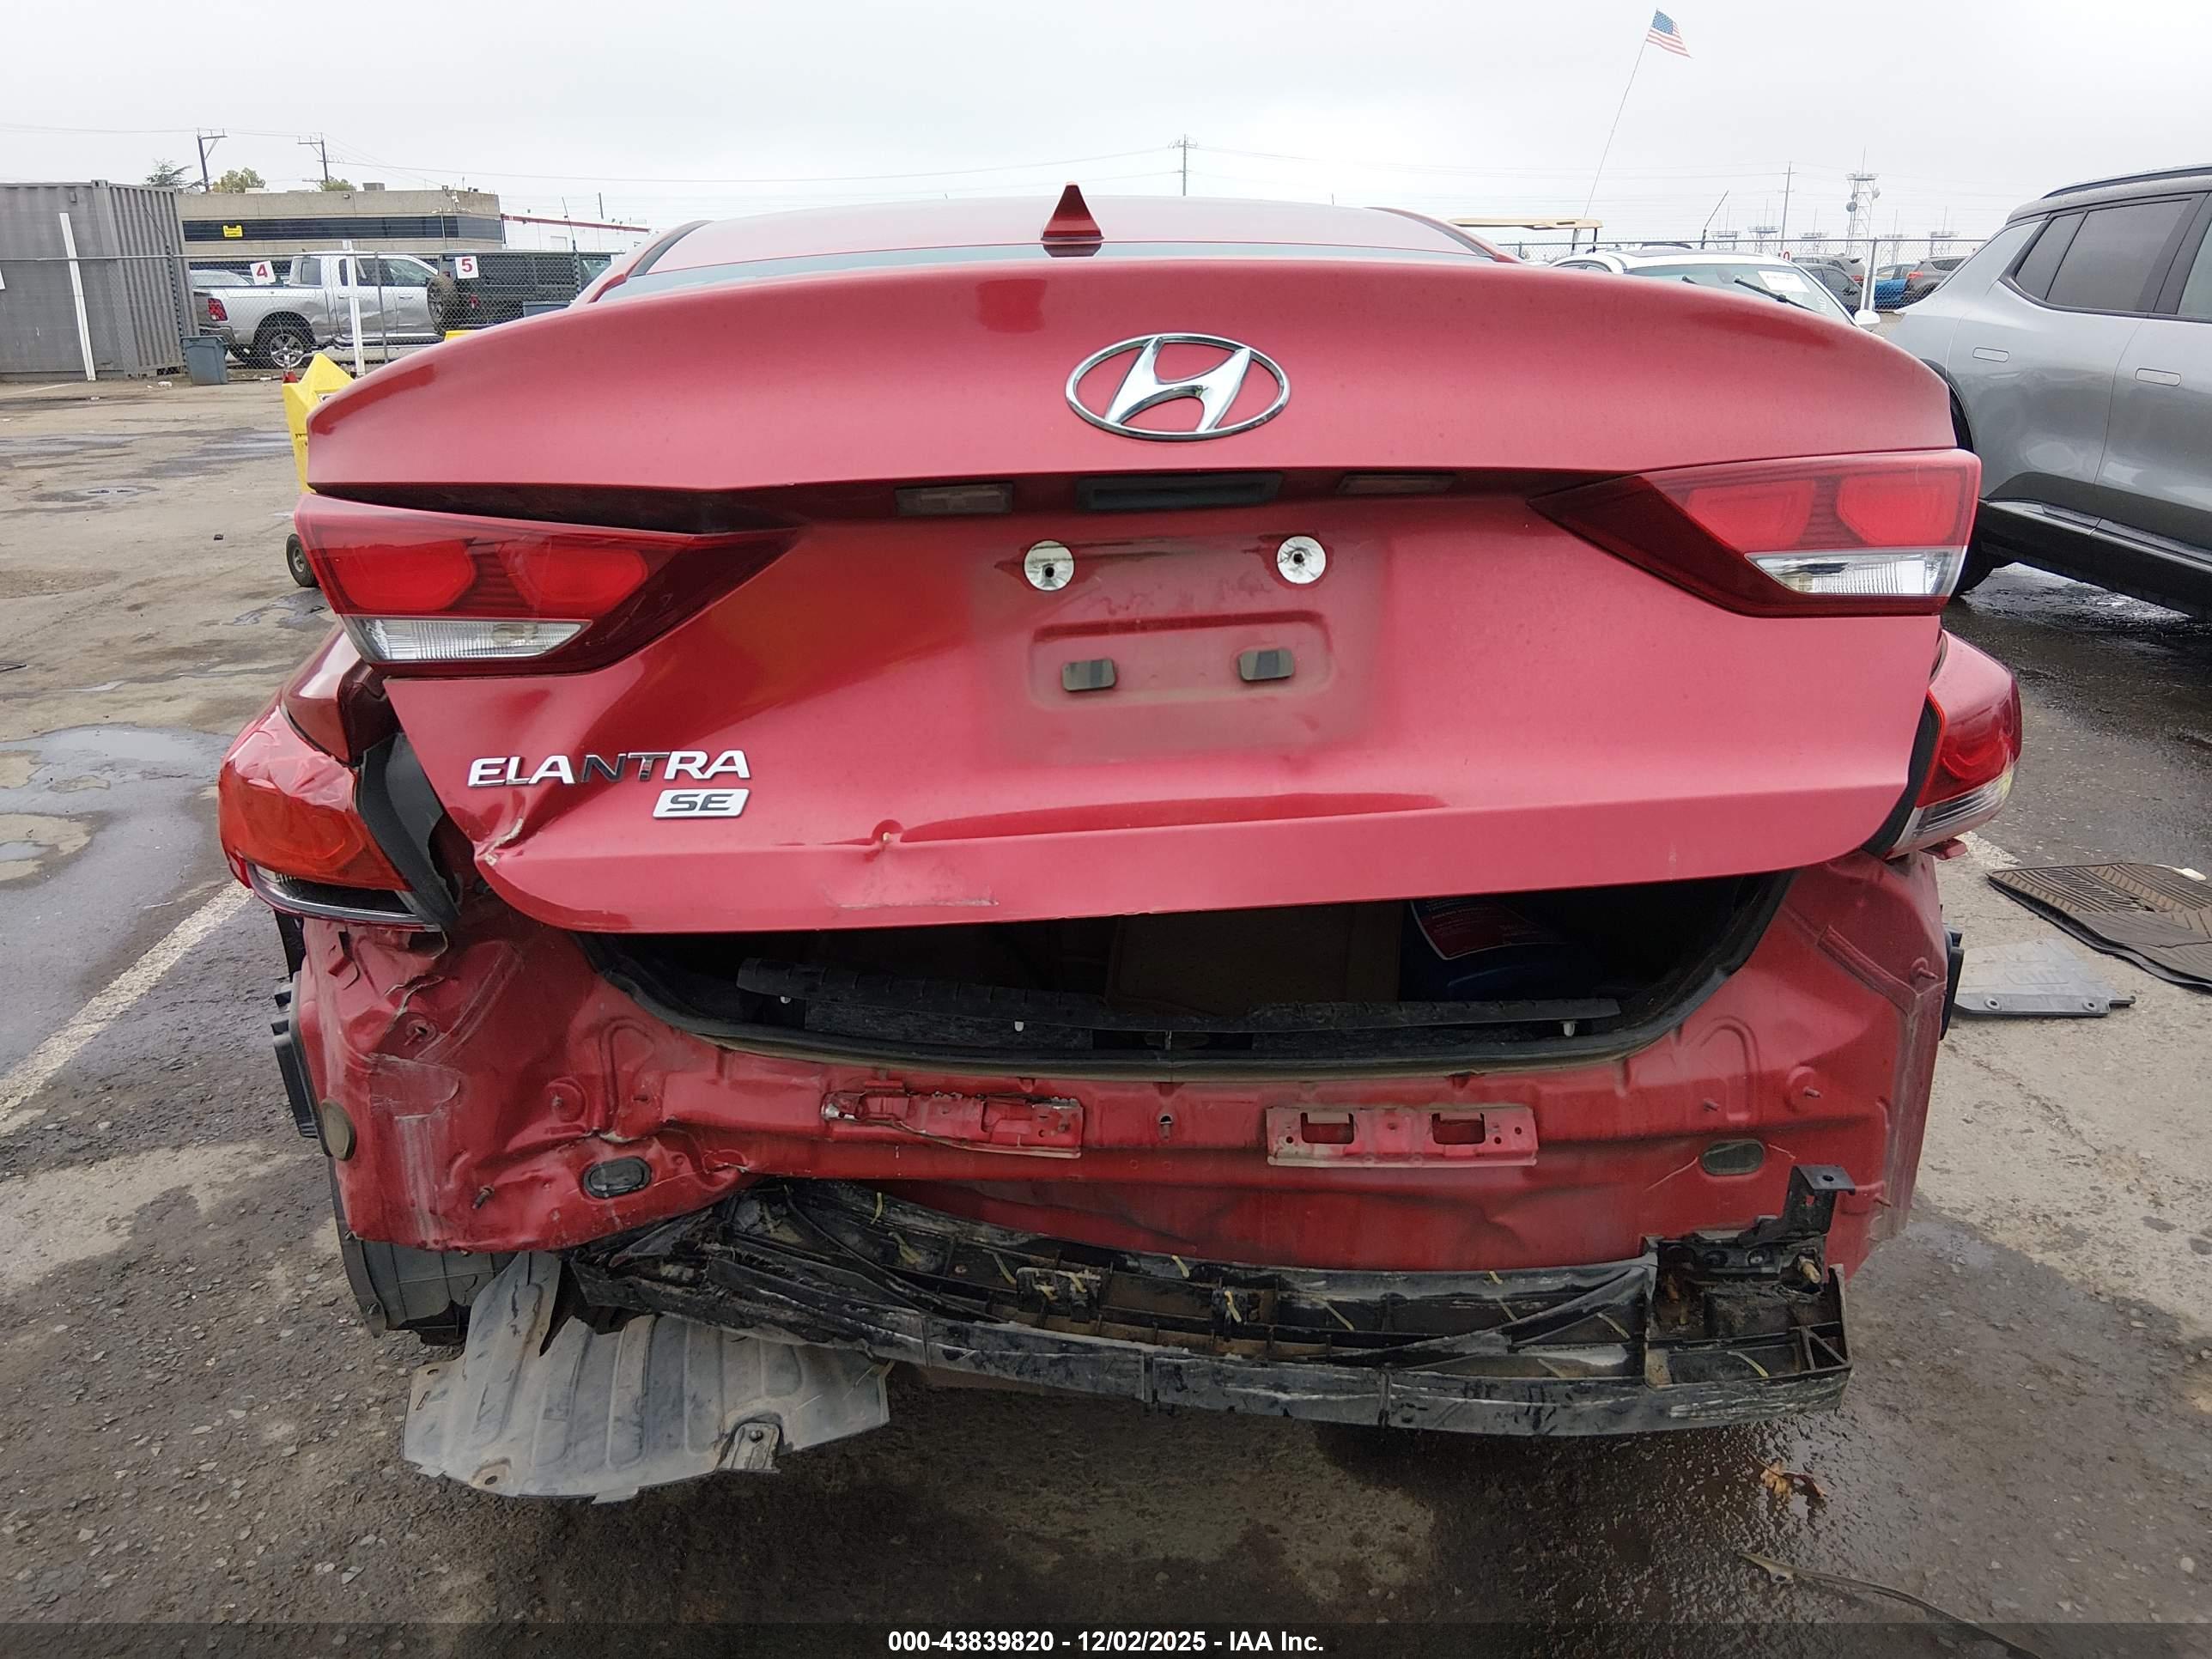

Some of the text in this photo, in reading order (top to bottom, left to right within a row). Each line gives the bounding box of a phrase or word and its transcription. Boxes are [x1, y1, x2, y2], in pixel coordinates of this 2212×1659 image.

[256, 264, 268, 278] 4
[461, 258, 473, 273] 5
[467, 750, 750, 787] ELANTRA
[665, 793, 733, 812] SE
